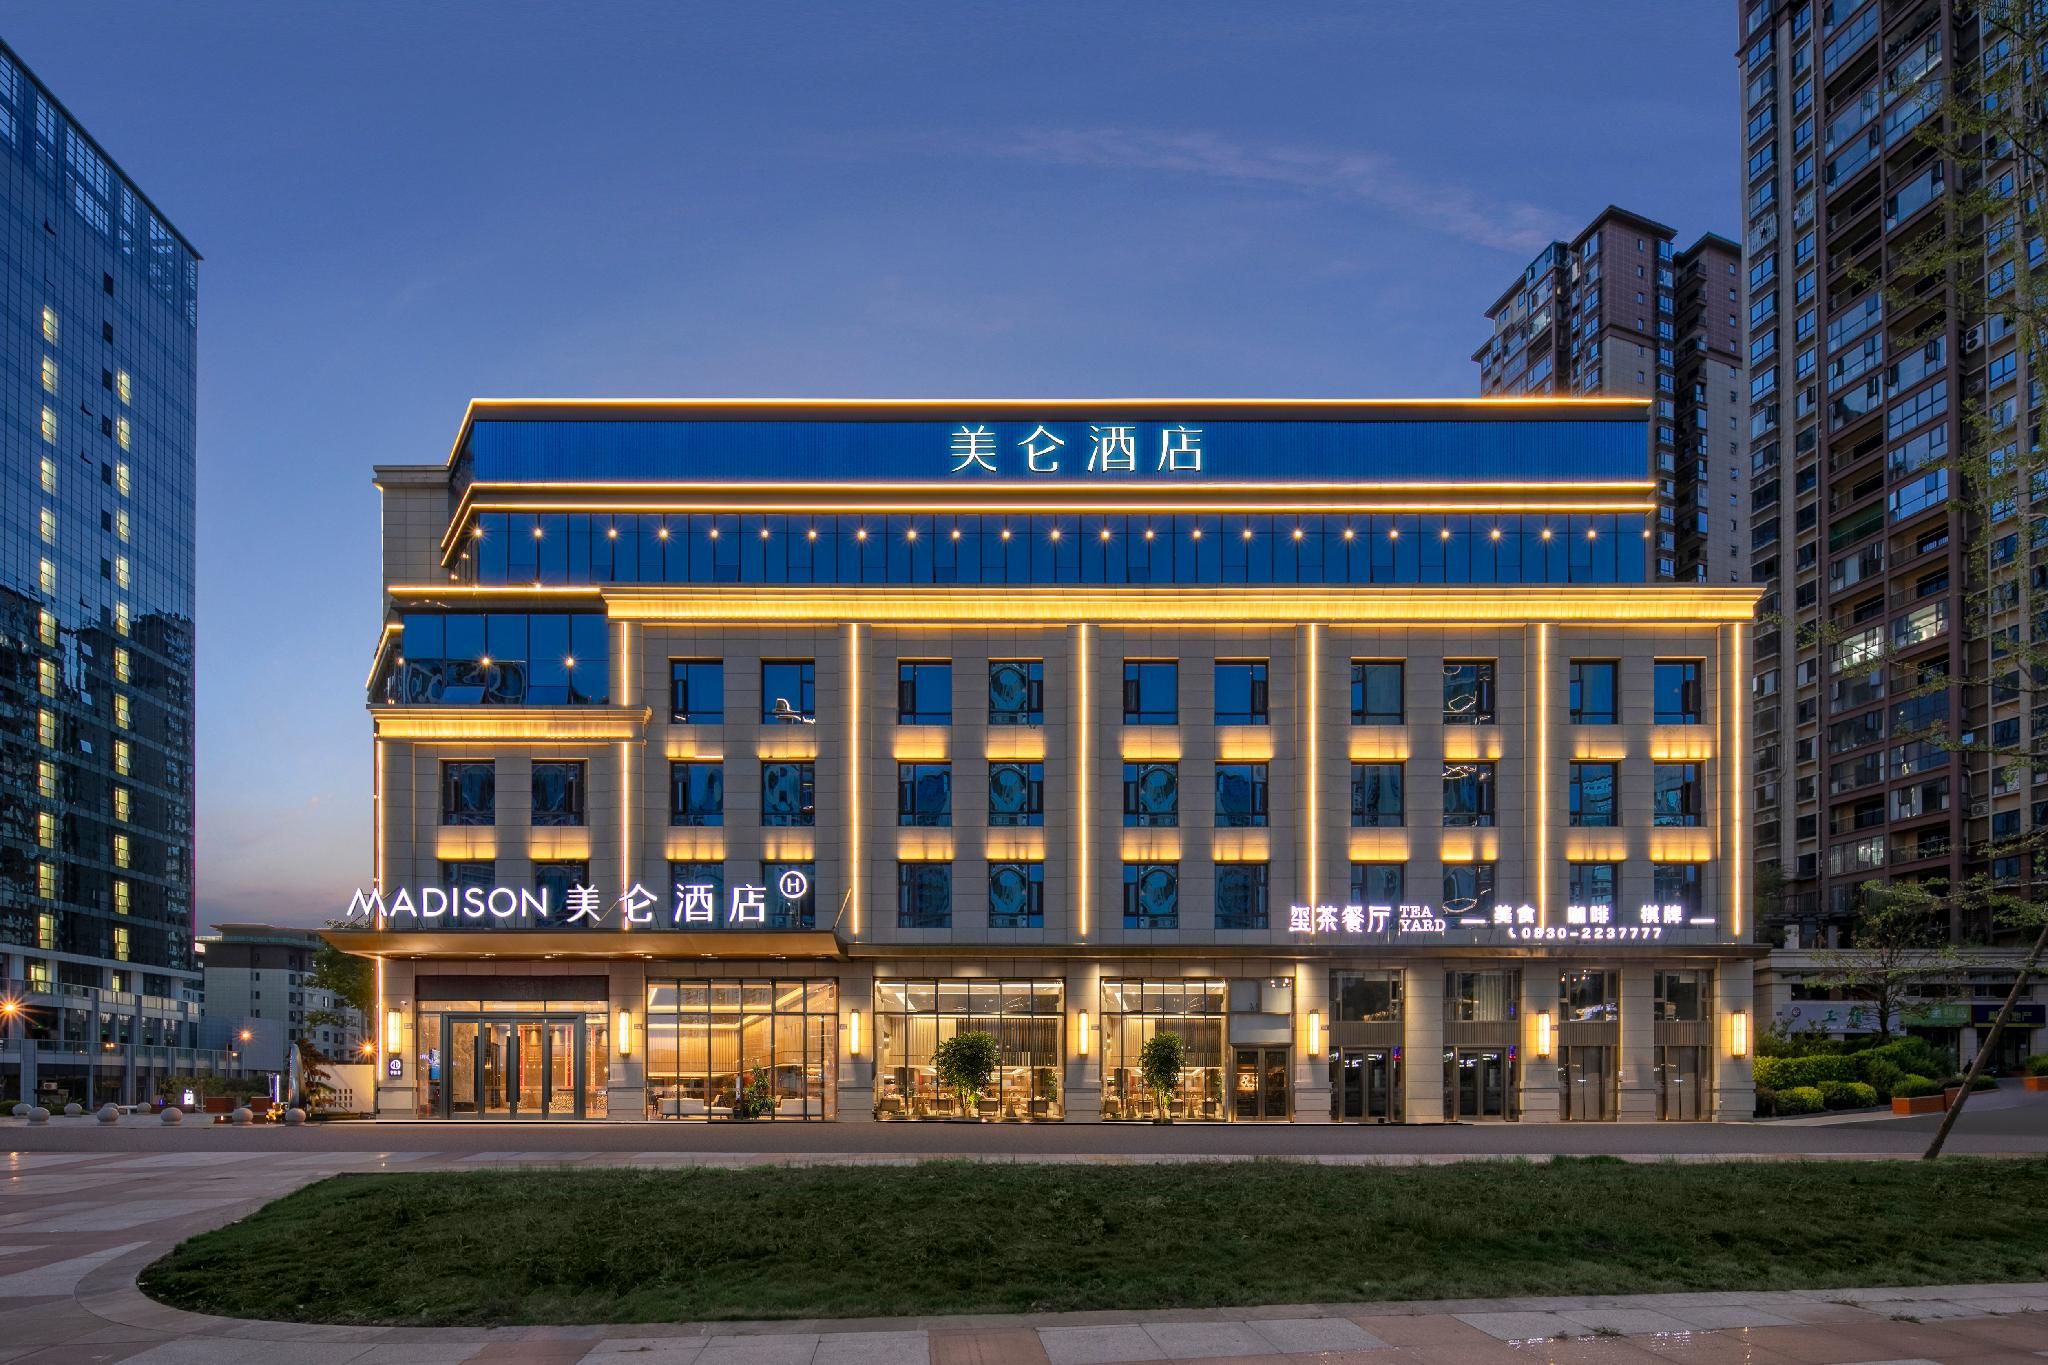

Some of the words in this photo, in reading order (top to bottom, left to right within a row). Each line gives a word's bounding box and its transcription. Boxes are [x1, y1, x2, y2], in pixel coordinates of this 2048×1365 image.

[950, 425, 1203, 471] 美仑酒店
[347, 887, 548, 918] MADISON
[566, 883, 768, 922] 美仑酒店
[1399, 906, 1433, 918] TEA
[1494, 905, 1536, 924] 美食
[1567, 905, 1610, 924] 咖啡
[1640, 905, 1684, 924] 棋牌
[1399, 919, 1447, 932] YARD
[1521, 928, 1663, 939] 0830-2237777
